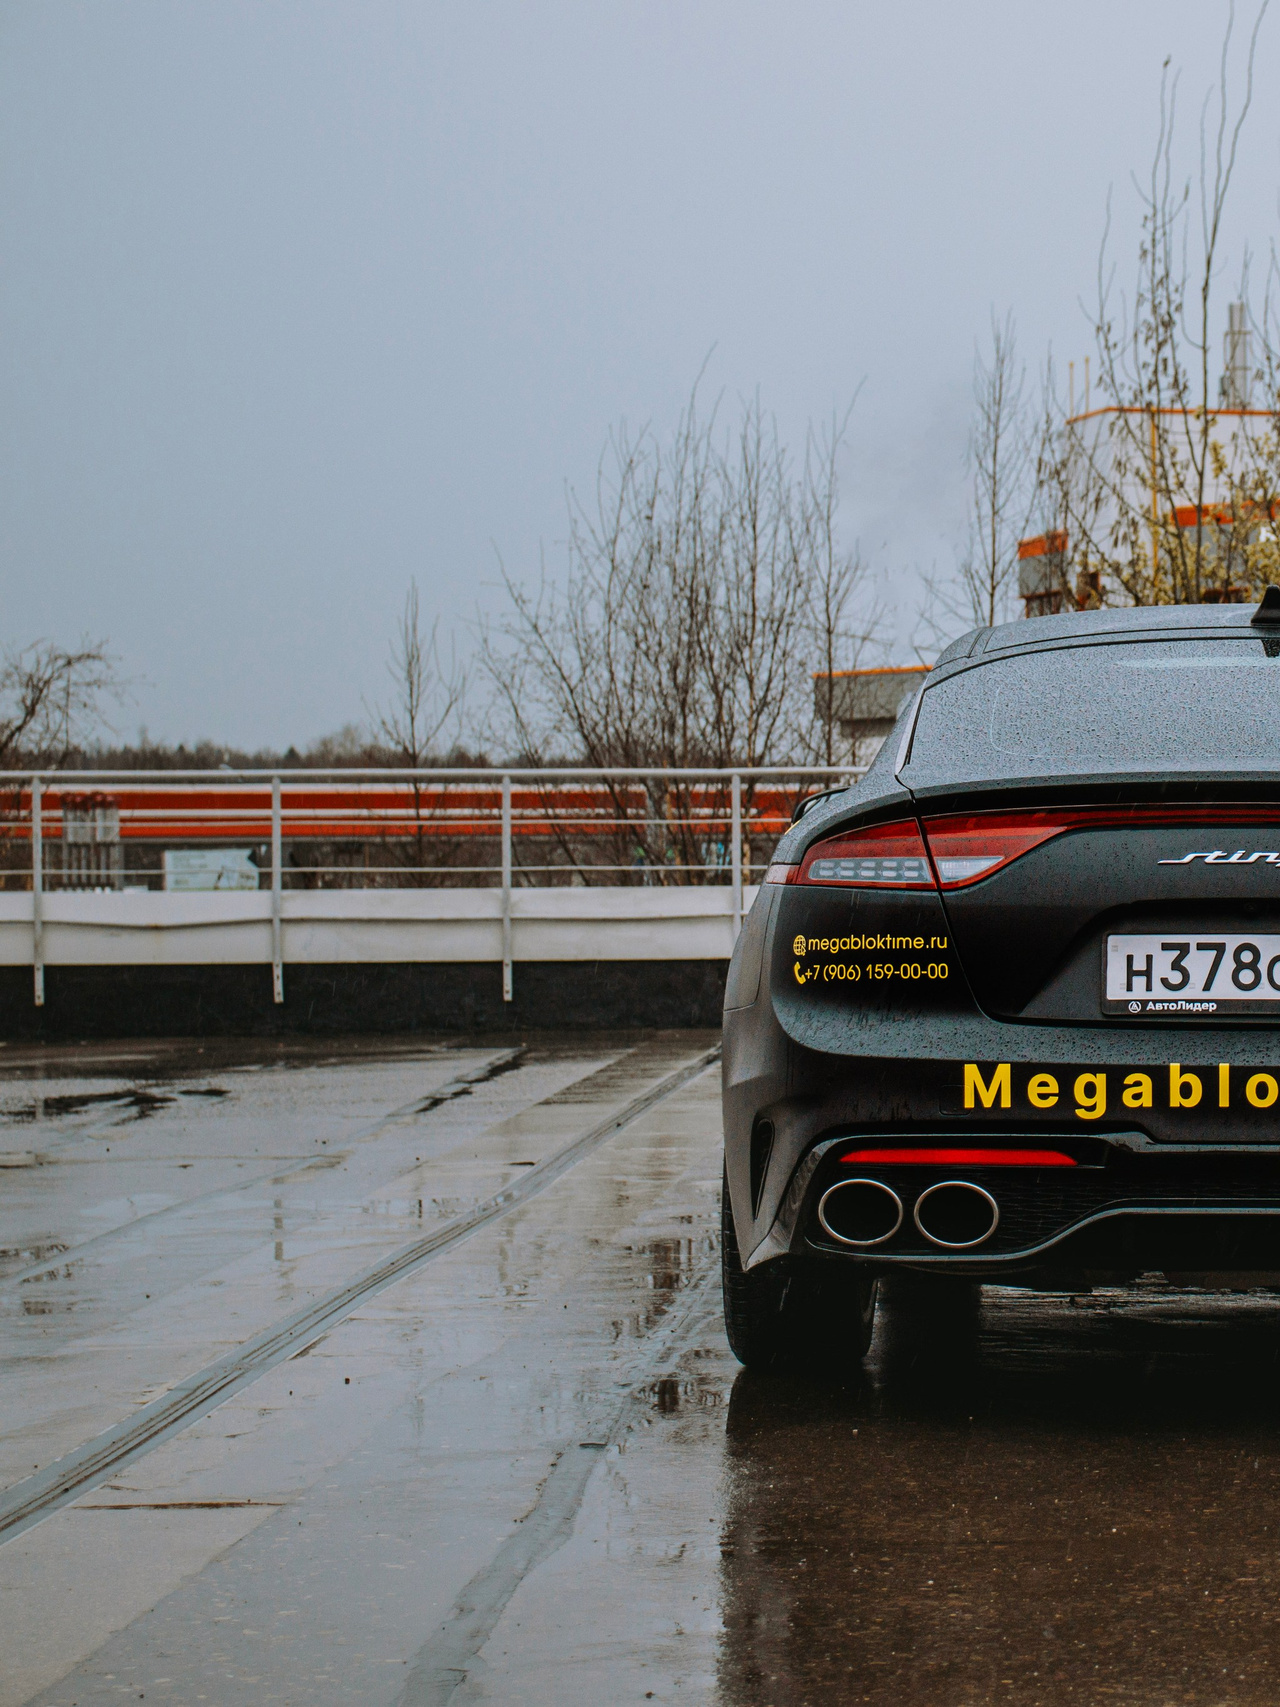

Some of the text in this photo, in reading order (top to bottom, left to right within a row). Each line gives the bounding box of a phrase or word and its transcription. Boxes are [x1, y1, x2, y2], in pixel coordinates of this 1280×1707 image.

[808, 934, 948, 954] megabloktime.ru
[805, 963, 949, 982] +7 (906) 159-00-00
[1146, 1000, 1218, 1012] АвтоЛидер
